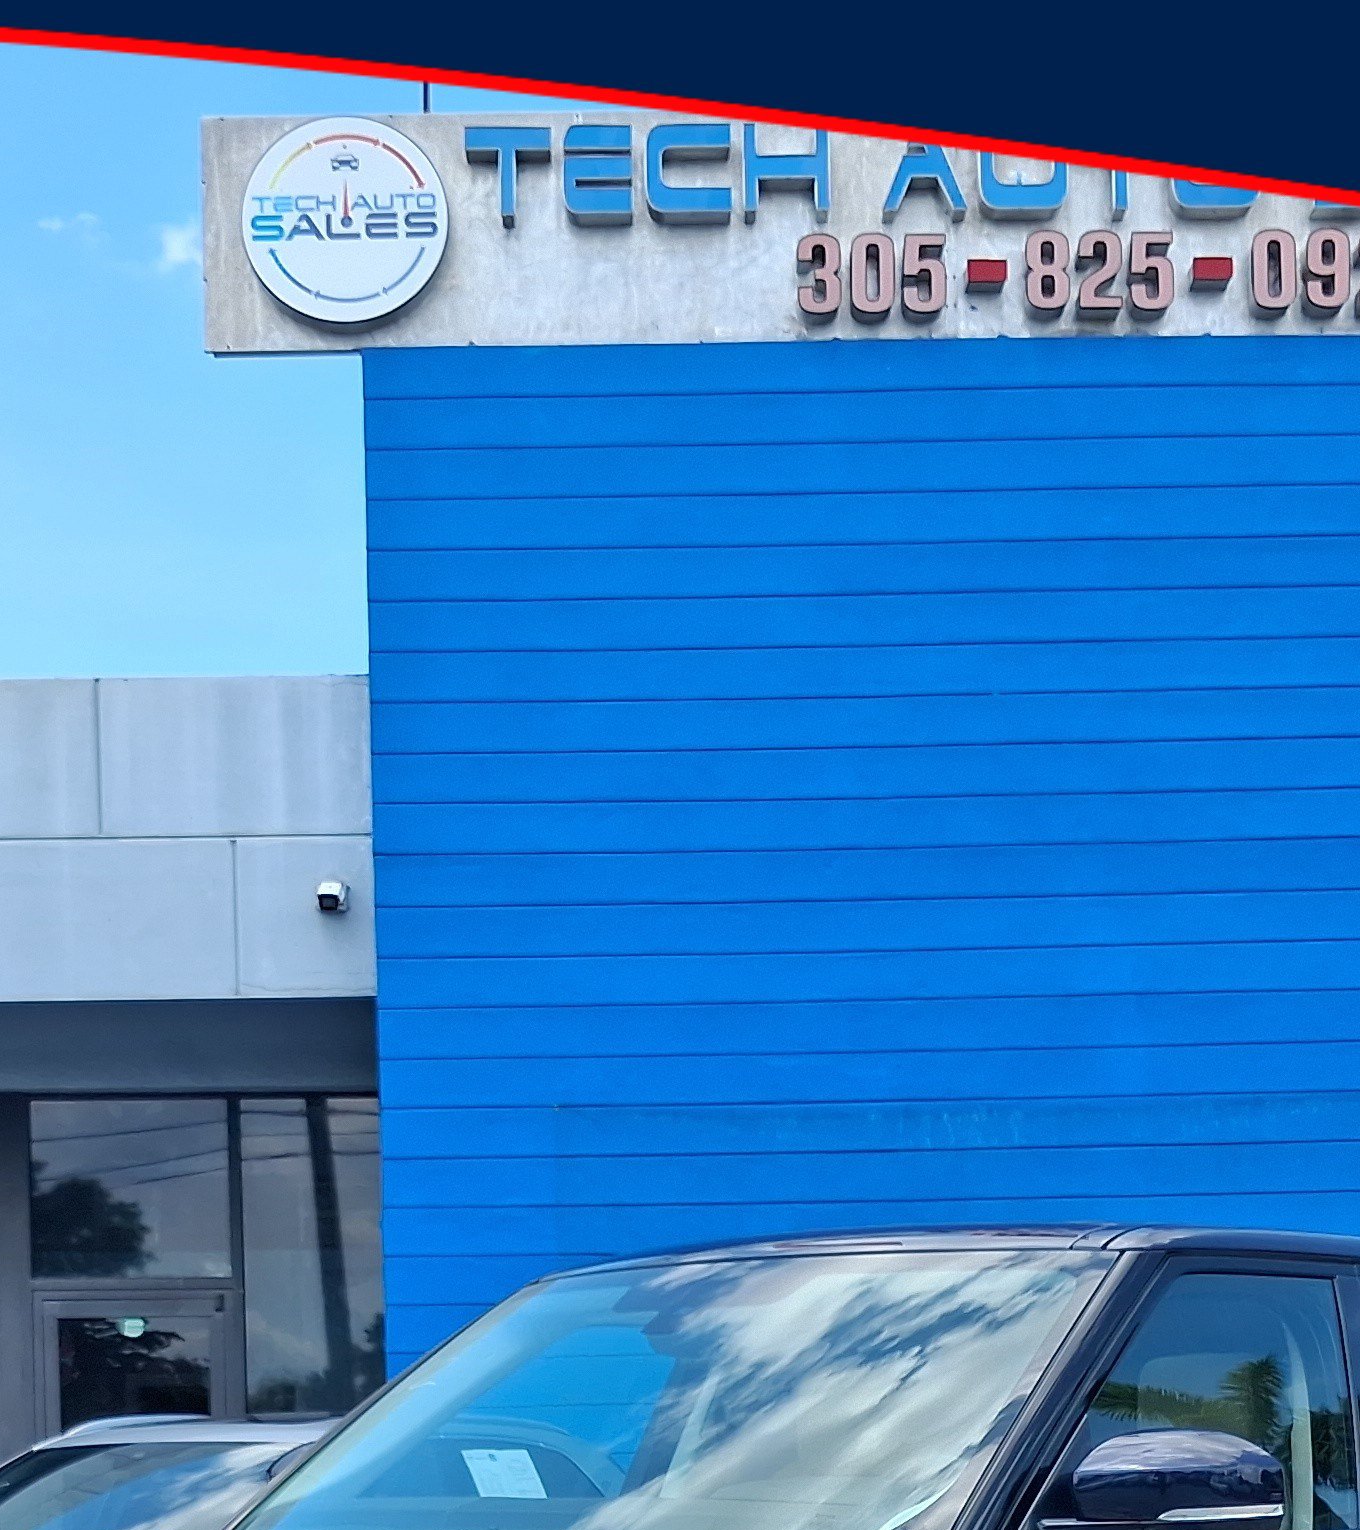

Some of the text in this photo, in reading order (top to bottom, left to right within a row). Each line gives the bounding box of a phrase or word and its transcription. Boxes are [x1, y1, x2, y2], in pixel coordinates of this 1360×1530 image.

[464, 122, 832, 228] TECH
[251, 192, 436, 214] TECH AUTO
[251, 211, 439, 242] SALES
